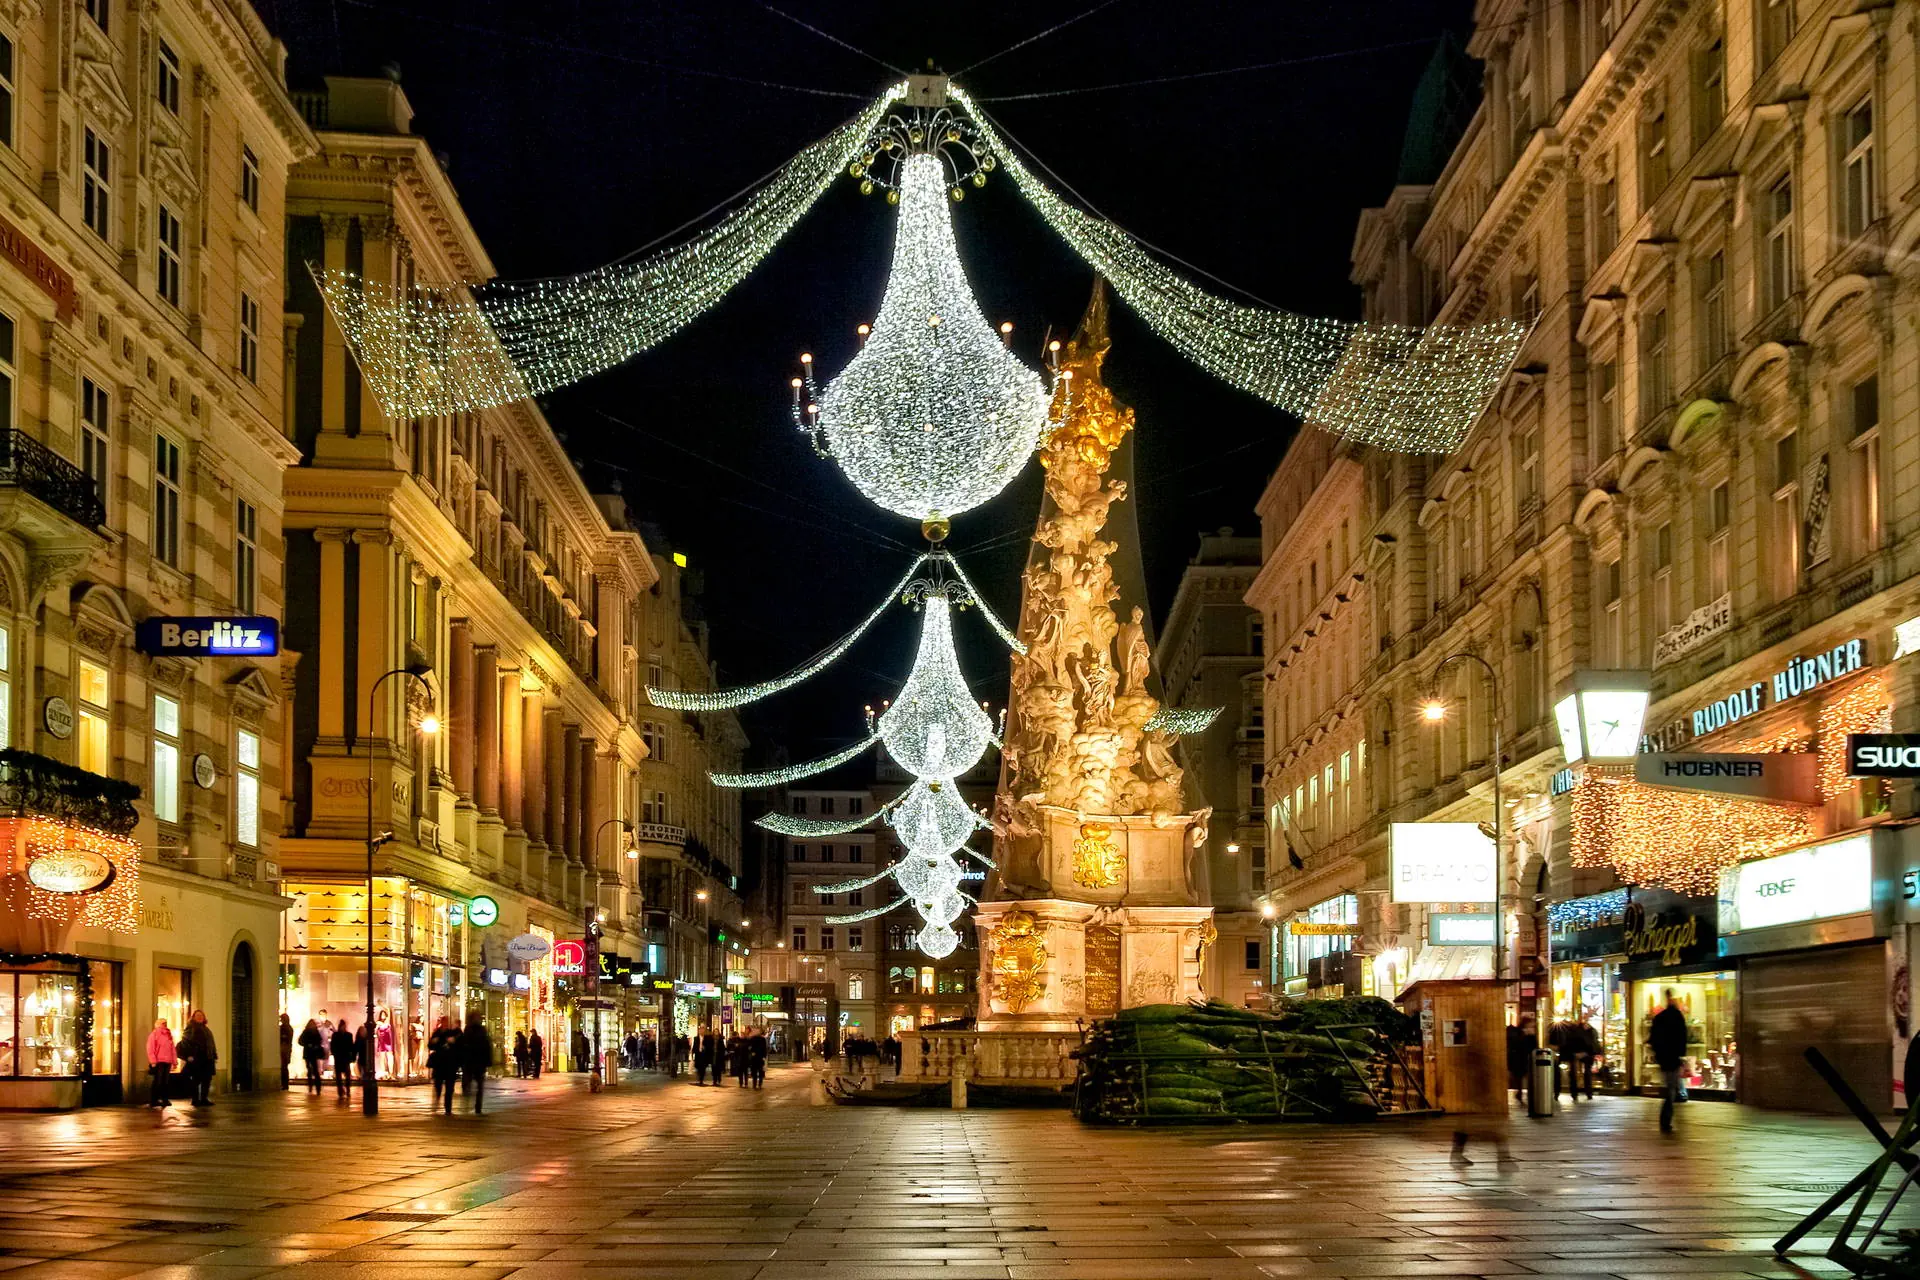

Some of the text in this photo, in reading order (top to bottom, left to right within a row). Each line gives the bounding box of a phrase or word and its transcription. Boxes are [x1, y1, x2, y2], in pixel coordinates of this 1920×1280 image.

[161, 621, 261, 648] Berlitz
[1692, 682, 1763, 737] RUDOLF
[1772, 638, 1862, 703] HÜBNER
[1664, 761, 1763, 777] HÜBNER
[797, 986, 824, 995] Cartier
